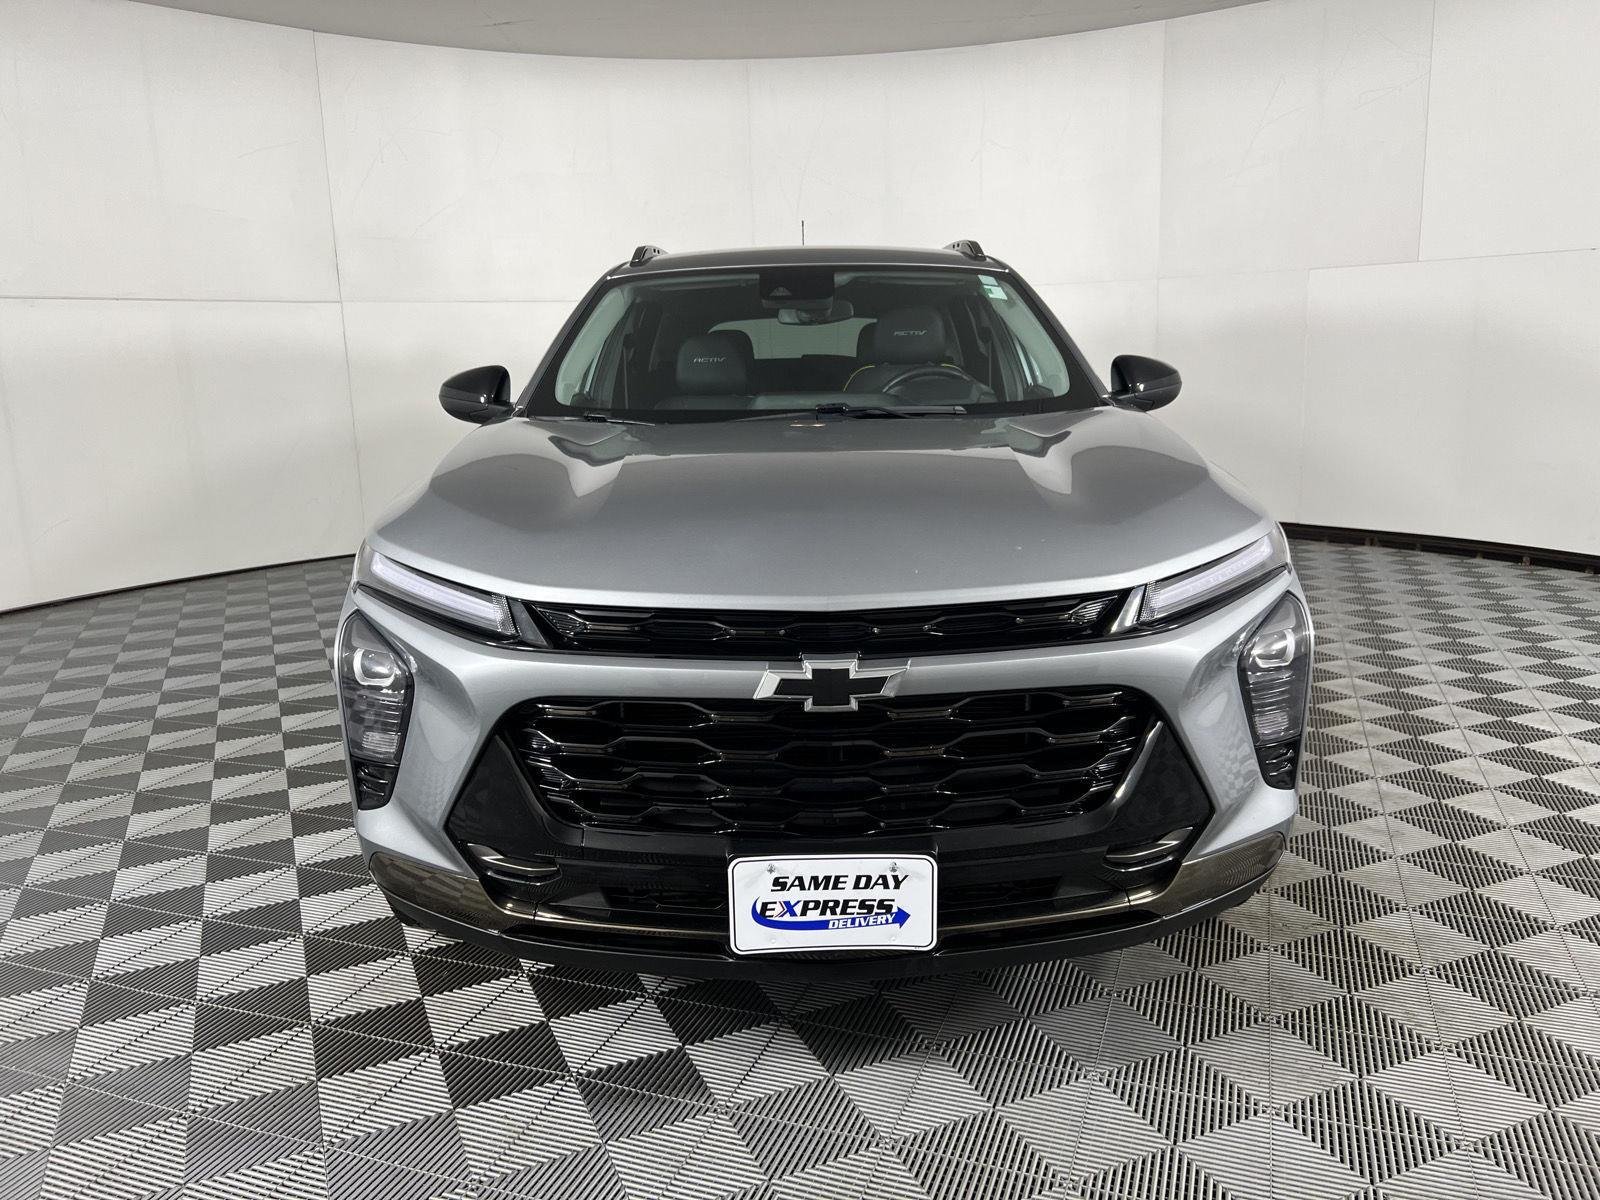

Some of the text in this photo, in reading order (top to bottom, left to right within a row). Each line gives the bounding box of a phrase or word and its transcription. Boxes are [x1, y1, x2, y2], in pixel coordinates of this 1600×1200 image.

[771, 874, 909, 892] SAME DAY
[760, 899, 895, 918] EXPRESS
[828, 914, 896, 929] DELIVERY
